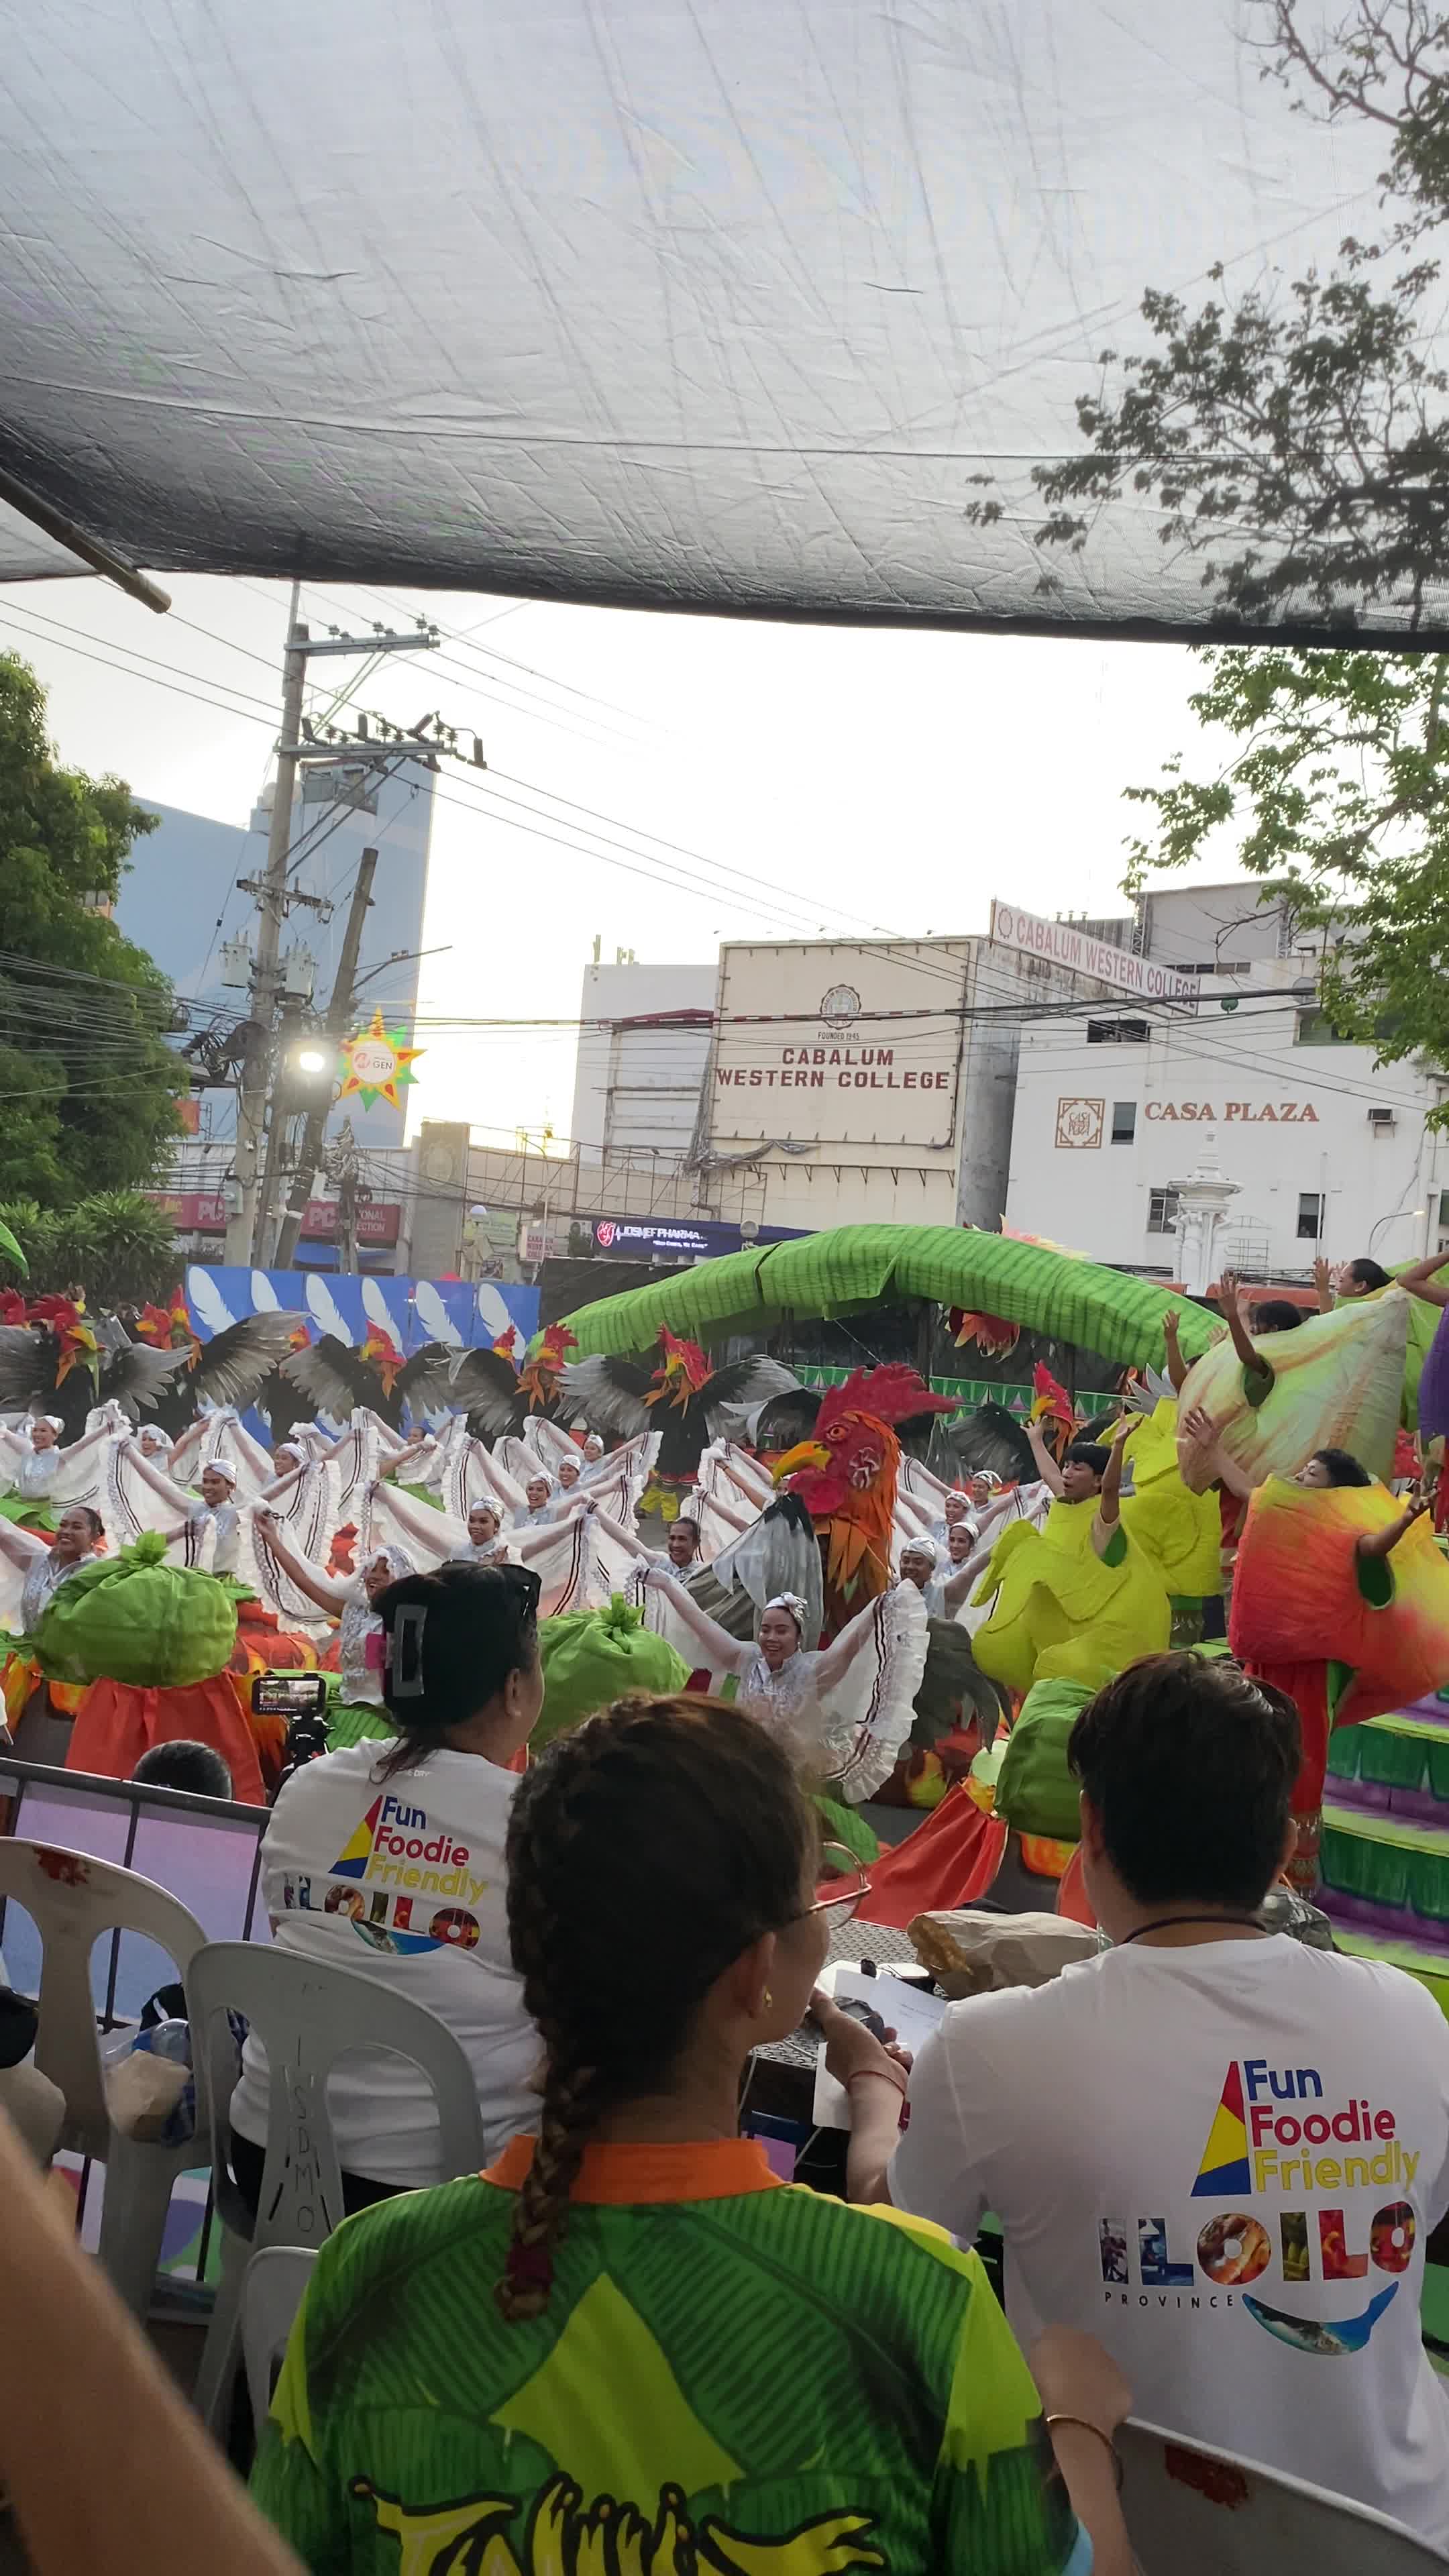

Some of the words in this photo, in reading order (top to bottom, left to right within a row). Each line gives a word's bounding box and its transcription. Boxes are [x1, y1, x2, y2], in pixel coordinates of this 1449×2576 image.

[1016, 916, 1082, 965] CABALUM
[1085, 942, 1144, 989] WESTERN
[1146, 967, 1196, 1008] COLLEGE
[818, 1031, 845, 1040] FOUNDED
[782, 1048, 894, 1066] CABALUM
[717, 1069, 824, 1087] WESTERN
[838, 1071, 950, 1089] COLLEGE
[1144, 1101, 1217, 1122] CASA
[1223, 1102, 1320, 1122] PLAZA
[380, 1796, 427, 1830] Fun
[374, 1825, 470, 1867] Foodie
[366, 1854, 488, 1906] Friendly
[1244, 2059, 1323, 2101] Fun
[1250, 2100, 1396, 2147] Foodie
[1252, 2141, 1421, 2194] Friendly
[1099, 2201, 1416, 2286] ILOILO
[1104, 2292, 1234, 2309] PROVINCE
